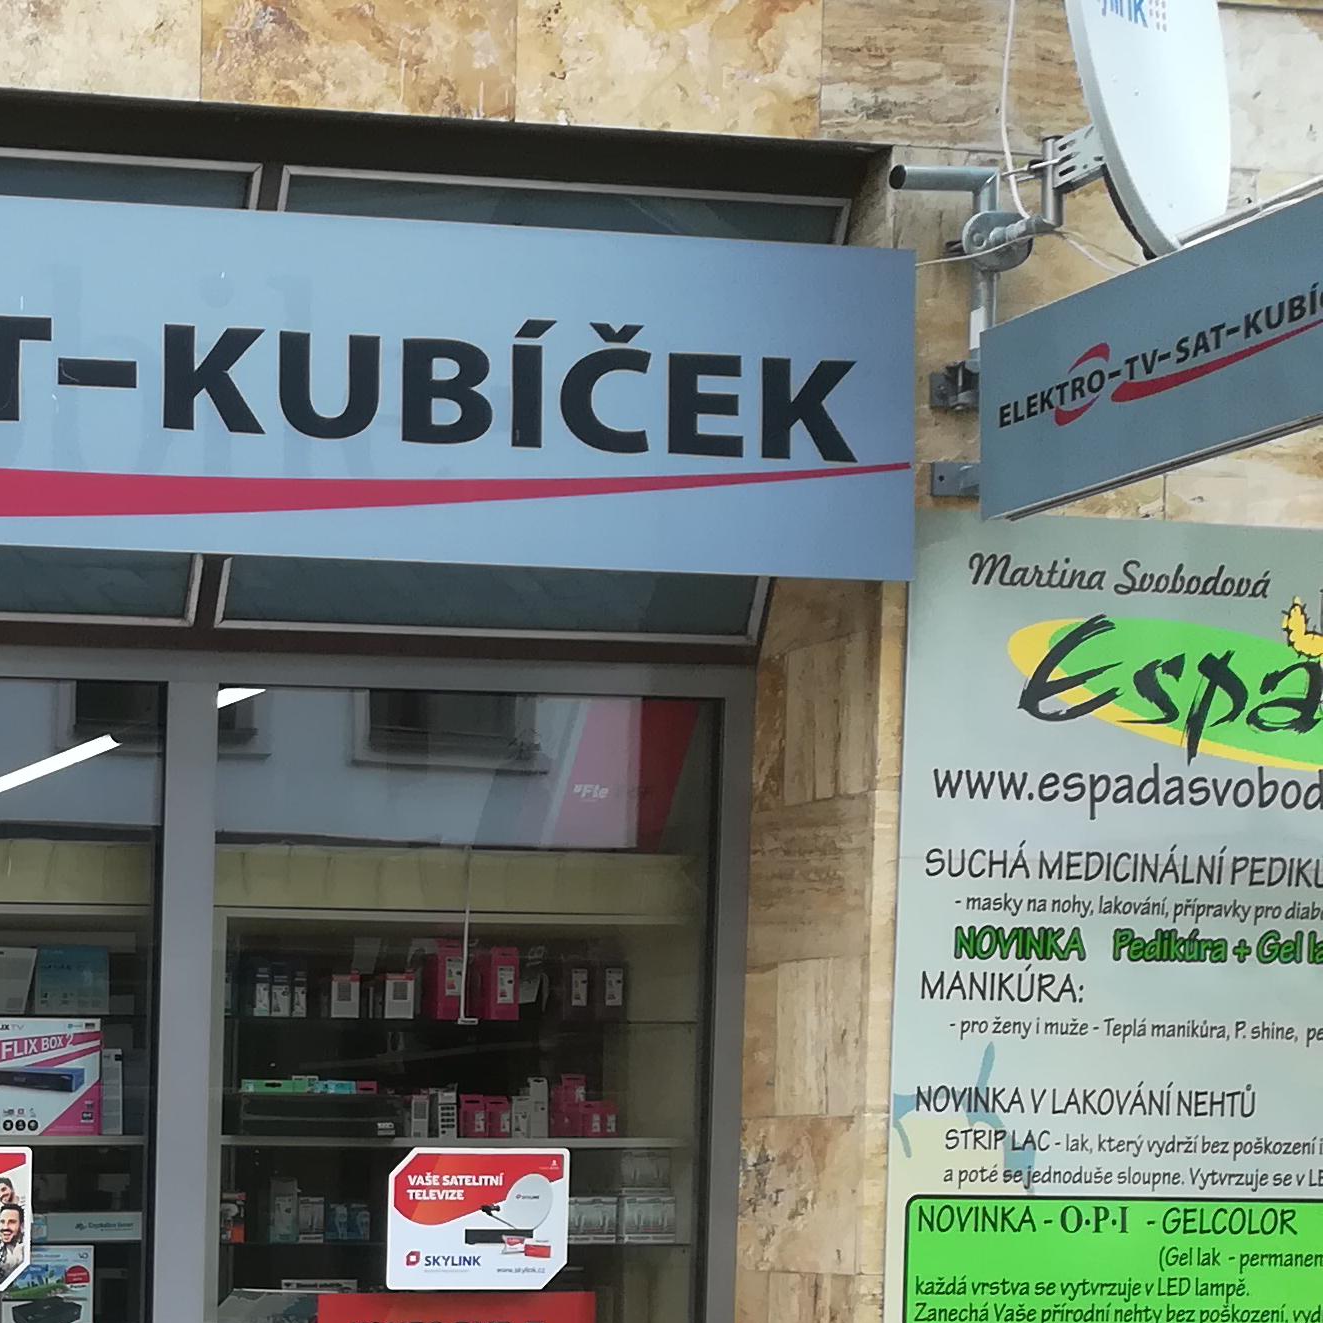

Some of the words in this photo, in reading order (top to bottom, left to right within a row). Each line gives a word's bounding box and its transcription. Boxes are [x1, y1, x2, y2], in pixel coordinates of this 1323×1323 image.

[998, 281, 1323, 429] ELEKTRO-TV-SAT-KUBÍ
[968, 551, 1105, 591] Martina
[1114, 559, 1272, 599] Svobodová
[1017, 613, 1323, 767] Espa
[932, 762, 1323, 820] www.espadasvobod
[925, 840, 1031, 880] SUCHÁ
[1038, 844, 1228, 886] MEDICINÁLNÍ
[965, 893, 1022, 916] masky
[1027, 896, 1048, 914] na
[1051, 895, 1095, 919] nohy,
[1098, 894, 1169, 918] lakování,
[1172, 897, 1251, 924] přípravky
[1254, 905, 1282, 926] pro
[1285, 900, 1323, 921] diab
[954, 925, 1087, 963] NOVINKA
[1112, 927, 1229, 964] Pedikúra
[1256, 928, 1304, 965] Gel
[920, 963, 1085, 1004] MANIKÚRA:
[959, 1020, 990, 1041] pro
[992, 1015, 1033, 1040] ženy
[1035, 1017, 1041, 1035] i
[1044, 1017, 1089, 1036] muže
[1103, 1017, 1148, 1043] Teplá
[1235, 1020, 1247, 1040] P.
[1250, 1020, 1299, 1043] shine,
[1, 1039, 39, 1060] FLIX
[41, 1035, 64, 1052] BOX
[915, 1085, 1023, 1114] NOVINKA
[1028, 1086, 1048, 1114] V
[1051, 1081, 1174, 1117] LAKOVÁNÍ
[1176, 1083, 1256, 1119] NEHTŮ
[944, 1128, 1007, 1153] STRIP
[1010, 1130, 1051, 1153] LAC
[1065, 1133, 1094, 1155] lak,
[1097, 1135, 1144, 1158] který
[1147, 1134, 1199, 1160] vydrží
[1201, 1137, 1230, 1156] bez
[1233, 1135, 1316, 1162] poškození
[407, 1172, 439, 1186] VAŠE
[441, 1172, 505, 1187] SATELITNÍ
[407, 1189, 465, 1200] TELEVIZE
[943, 1168, 954, 1183] a
[957, 1166, 998, 1190] poté
[1002, 1168, 1023, 1184] se
[1023, 1165, 1114, 1190] jednoduše
[1117, 1167, 1186, 1191] sloupne.
[1189, 1167, 1270, 1193] Vytvrzuje
[1272, 1172, 1293, 1187] se
[1295, 1173, 1306, 1187] v
[916, 1205, 1037, 1234] NOVINKA
[1161, 1206, 1299, 1236] GELCOLOR
[424, 1255, 482, 1267] SKYLINK
[1158, 1246, 1194, 1273] (Gel
[1195, 1247, 1222, 1267] lak
[915, 1275, 968, 1297] každá
[971, 1278, 1030, 1297] vrstva
[1034, 1281, 1057, 1297] se
[1059, 1278, 1143, 1303] vytvrzuje
[1145, 1281, 1155, 1297] v
[1157, 1278, 1192, 1298] LED
[1194, 1276, 1251, 1304] lampě.
[913, 1302, 991, 1323] Zanechá
[993, 1303, 1038, 1323] Vaše
[1166, 1305, 1196, 1323] bez
